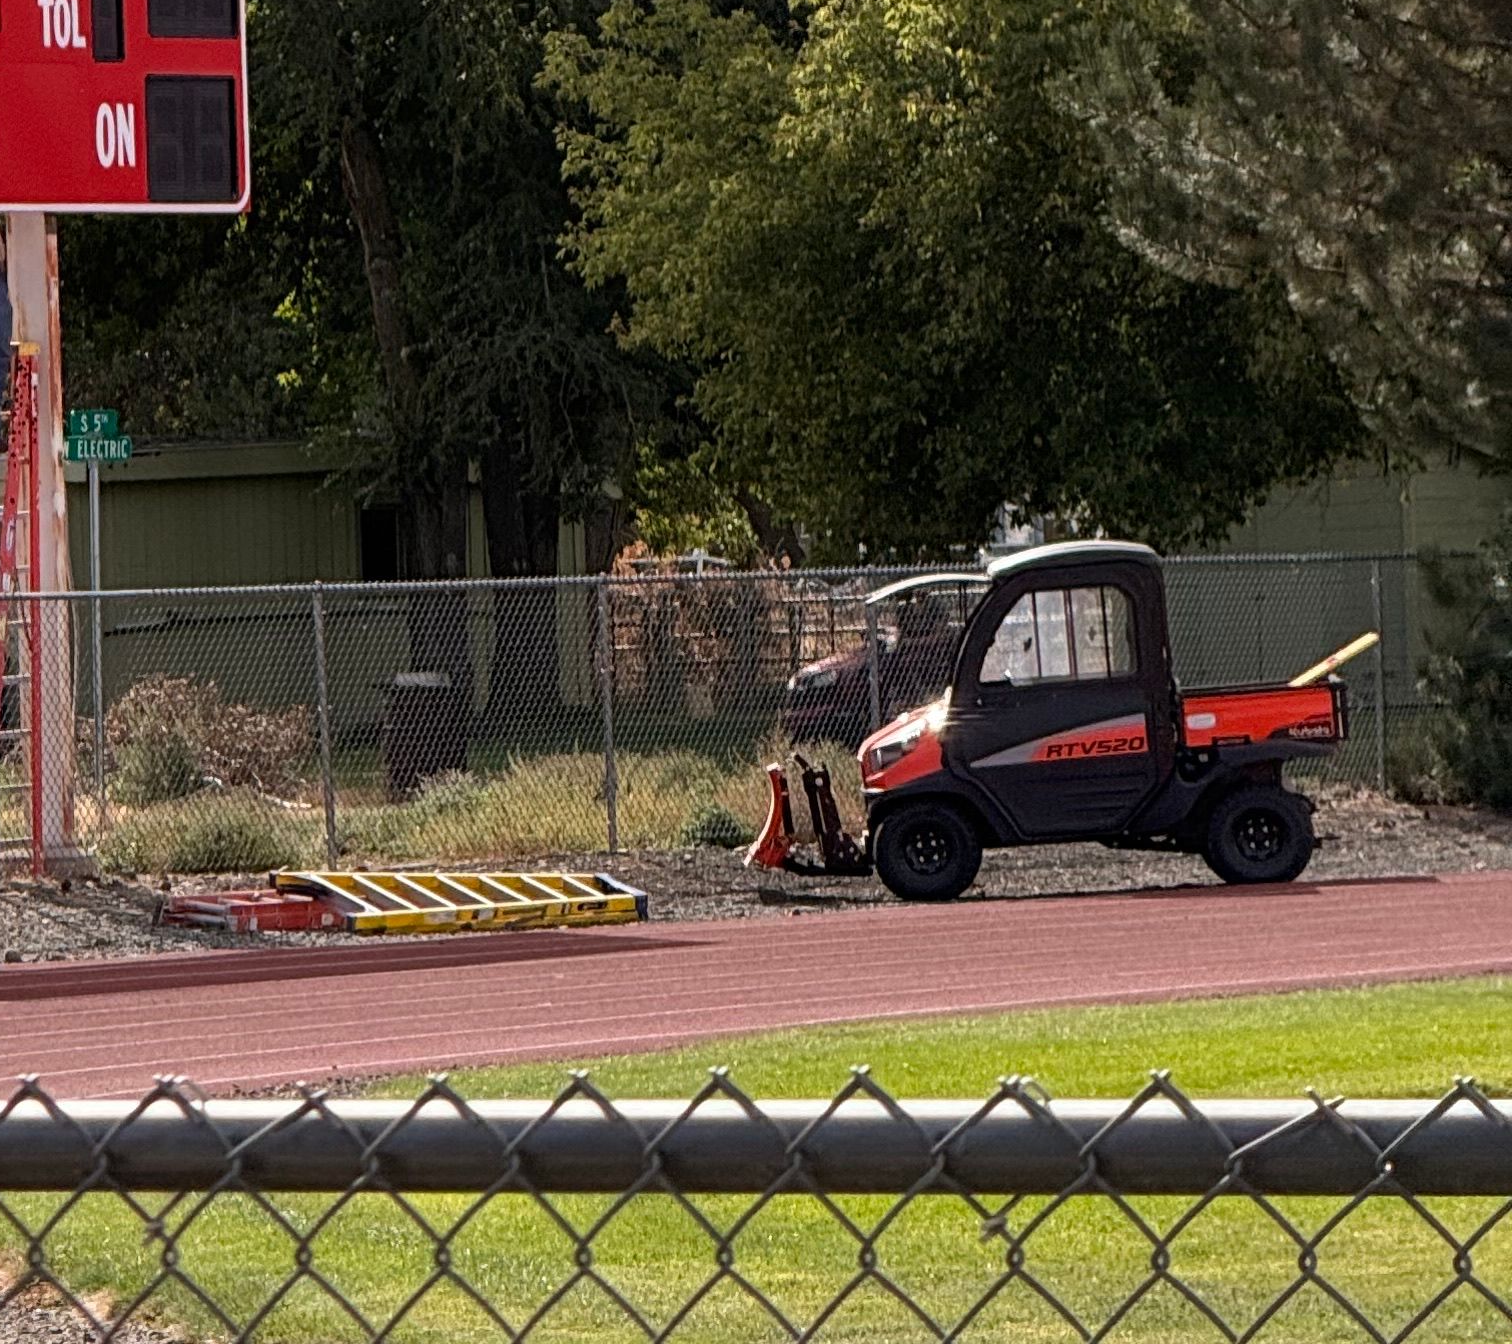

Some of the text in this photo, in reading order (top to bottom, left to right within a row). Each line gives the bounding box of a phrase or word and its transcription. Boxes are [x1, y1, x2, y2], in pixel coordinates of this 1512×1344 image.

[95, 102, 136, 168] ON
[80, 413, 88, 433] S
[77, 439, 128, 460] ELECTRIC
[1046, 736, 1145, 758] RTV520
